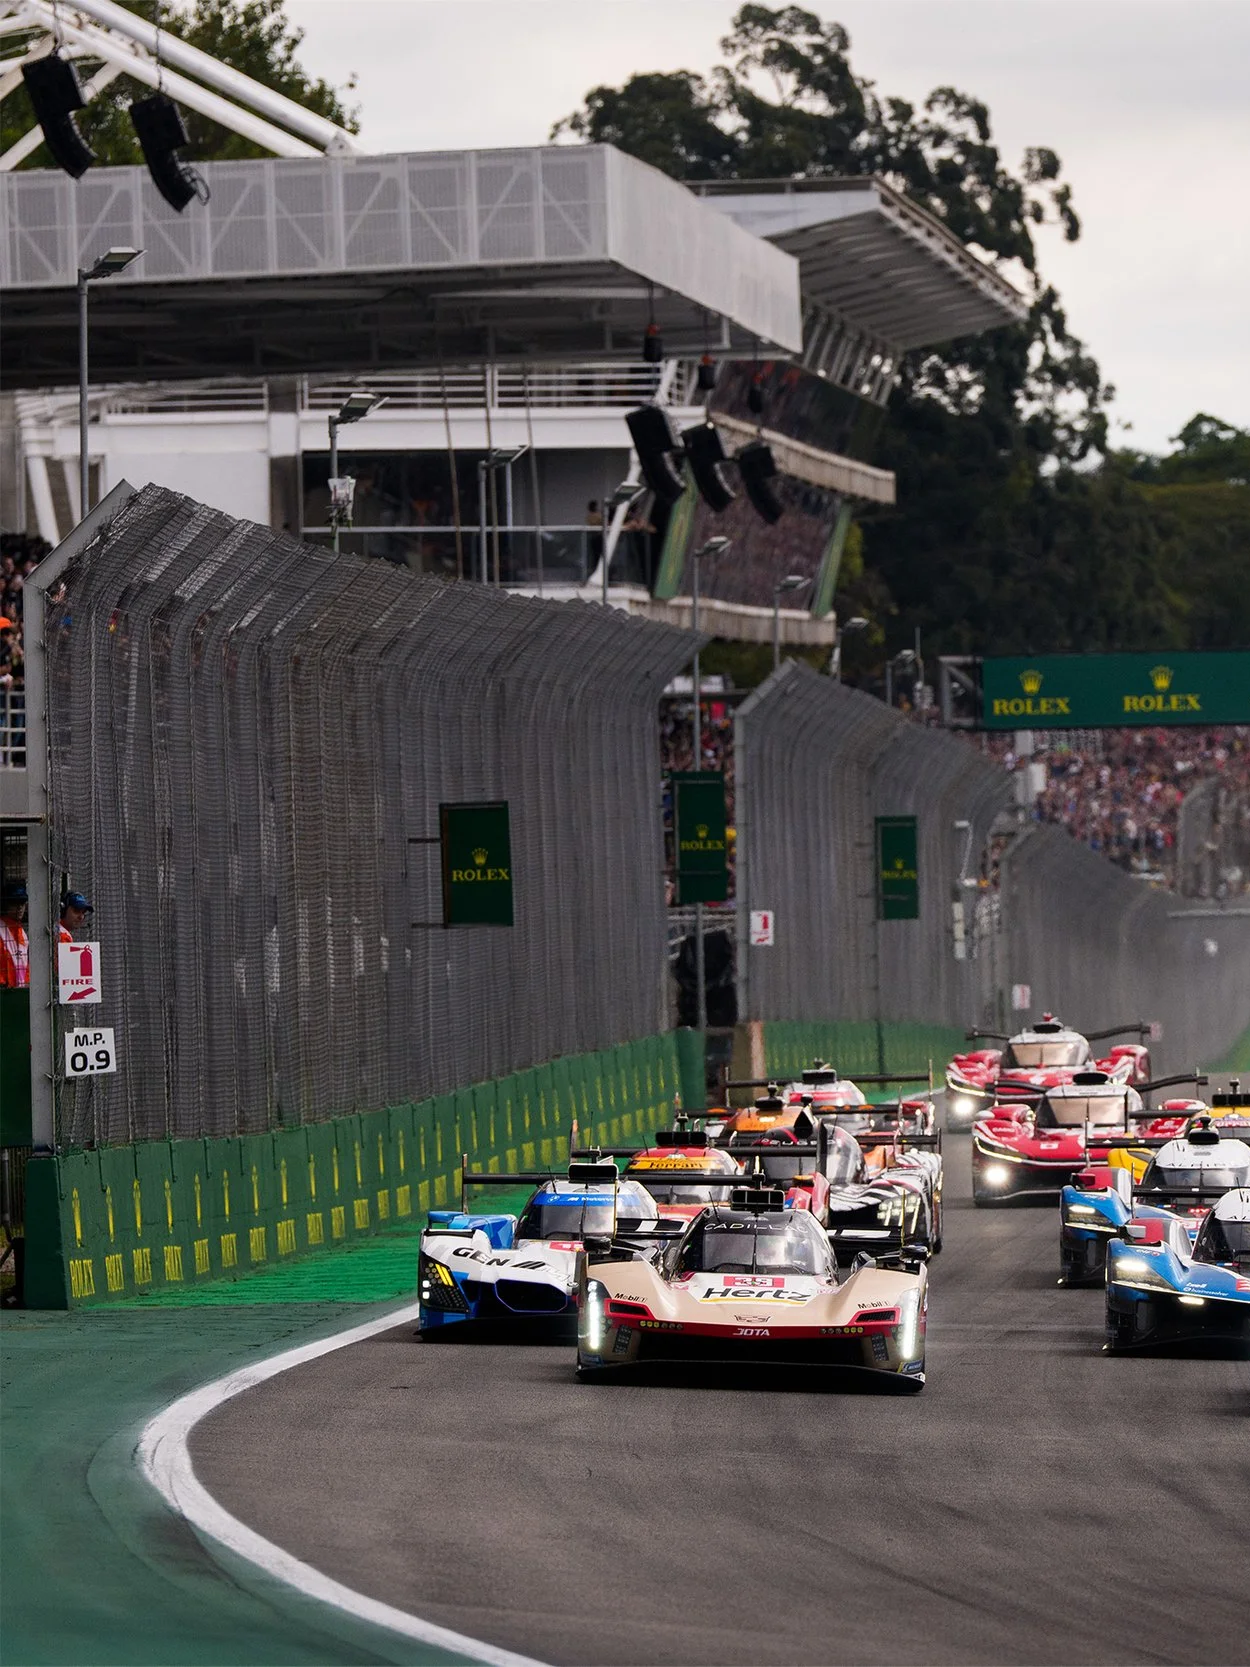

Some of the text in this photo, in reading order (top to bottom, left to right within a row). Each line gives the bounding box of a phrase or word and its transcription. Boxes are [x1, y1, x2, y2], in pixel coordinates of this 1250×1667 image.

[993, 697, 1071, 716] ROLEX
[1123, 693, 1202, 712] ROLEX
[680, 840, 725, 851] ROLEX
[451, 868, 510, 882] ROLEX
[62, 978, 94, 986] FIRE
[74, 1032, 106, 1047] M.P.
[70, 1049, 111, 1073] 0.9
[703, 1222, 809, 1234] CADILLAC
[452, 1246, 510, 1267] GEN
[614, 1293, 639, 1302] Mobil
[702, 1287, 812, 1302] Hertz
[857, 1301, 883, 1310] Mobil
[733, 1328, 770, 1337] JOTA
